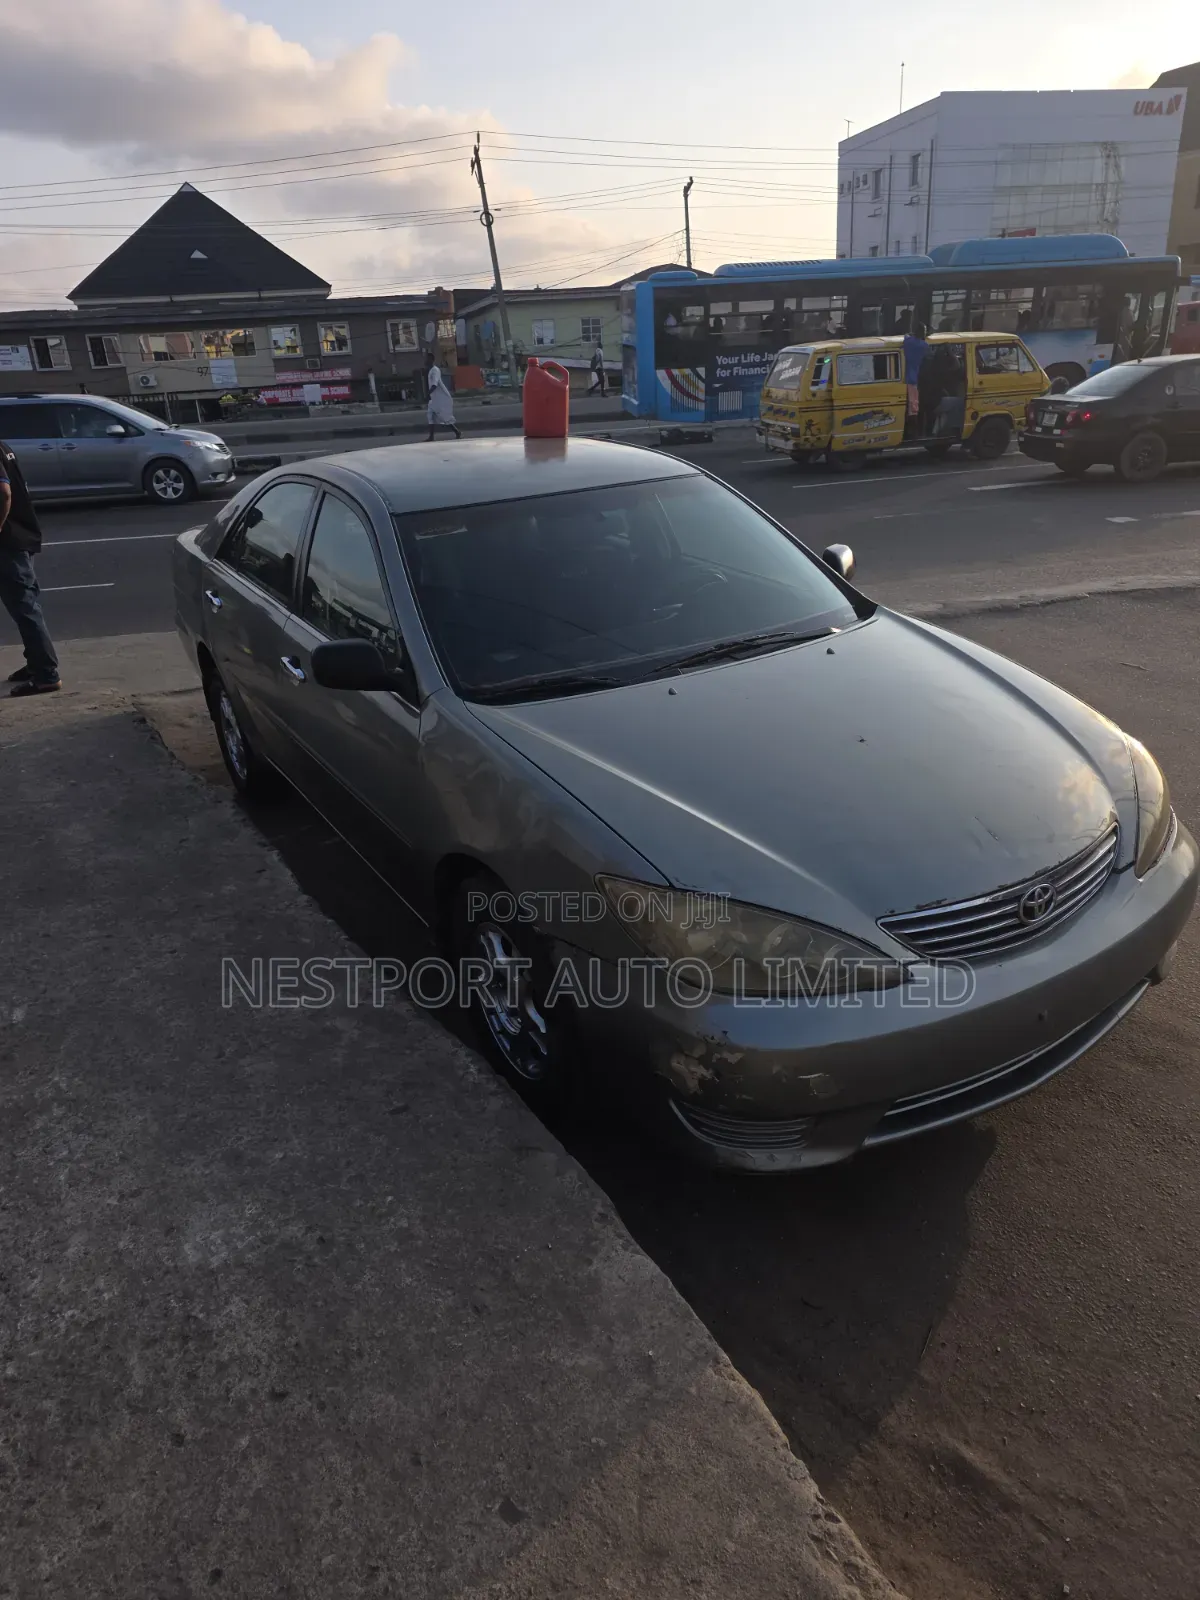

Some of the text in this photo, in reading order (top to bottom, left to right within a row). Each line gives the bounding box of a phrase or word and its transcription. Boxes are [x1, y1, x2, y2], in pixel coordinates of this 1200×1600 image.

[1133, 100, 1163, 116] UBA
[715, 355, 740, 365] Your
[741, 353, 761, 363] Life
[197, 366, 208, 377] 97
[715, 368, 731, 378] for
